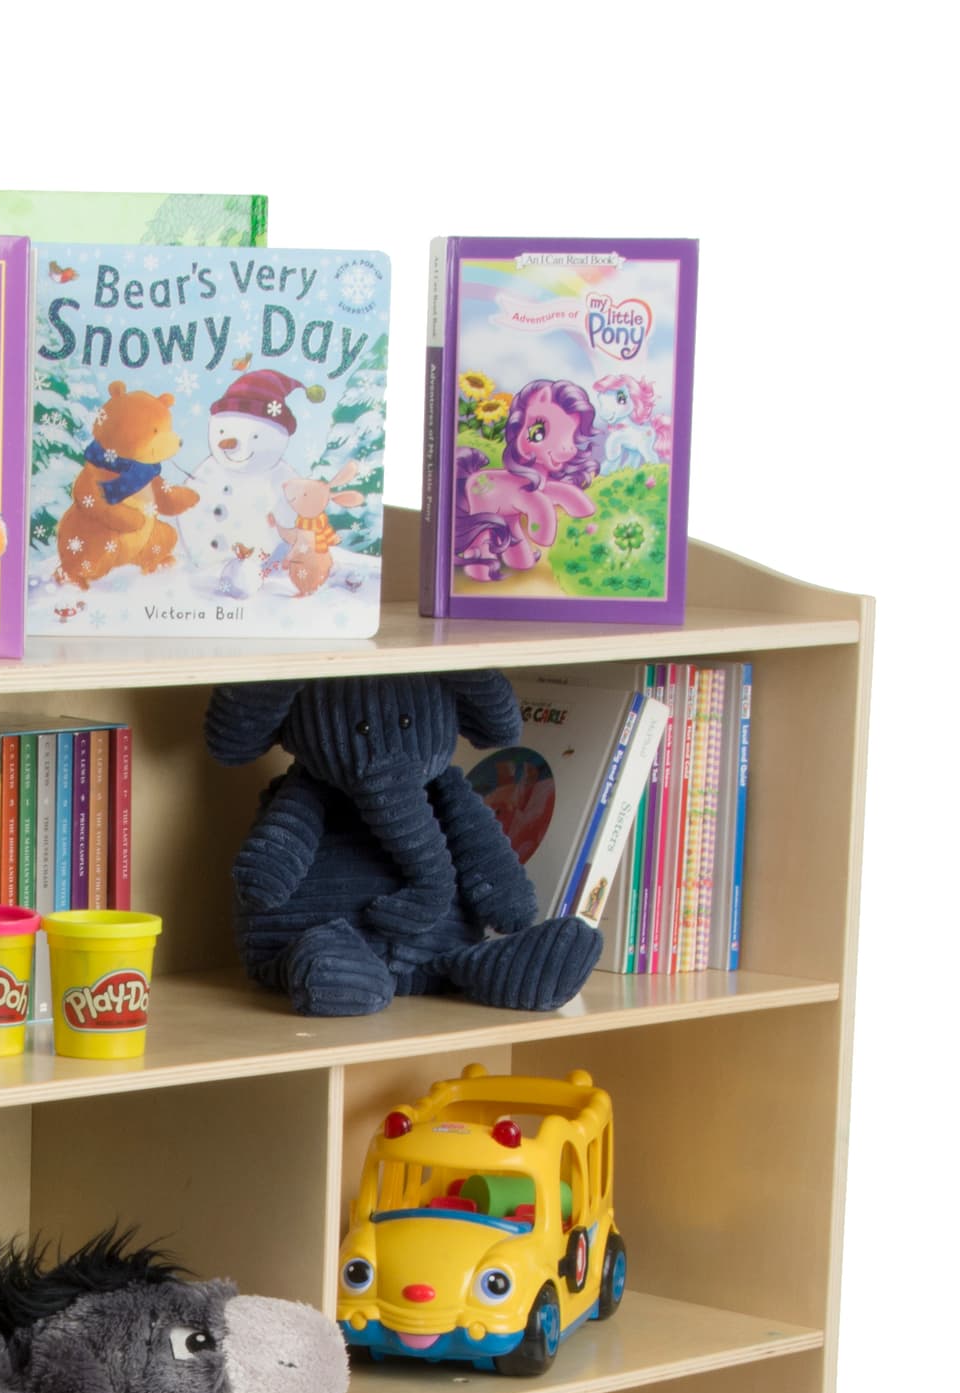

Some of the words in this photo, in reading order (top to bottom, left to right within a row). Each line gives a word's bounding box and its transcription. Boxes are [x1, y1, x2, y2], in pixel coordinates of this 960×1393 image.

[526, 254, 540, 265] An
[546, 254, 565, 265] Can
[566, 254, 589, 265] Read
[590, 254, 614, 265] Book
[94, 262, 217, 310] Bear's
[229, 260, 318, 301] Very
[39, 297, 231, 370] Snowy
[261, 304, 368, 380] Day
[512, 311, 566, 325] Adventures
[568, 310, 581, 319] of
[607, 307, 644, 326] little
[588, 312, 645, 360] Pony
[144, 604, 206, 621] Victoria
[216, 605, 244, 621] Ball
[608, 801, 631, 853] Sisters
